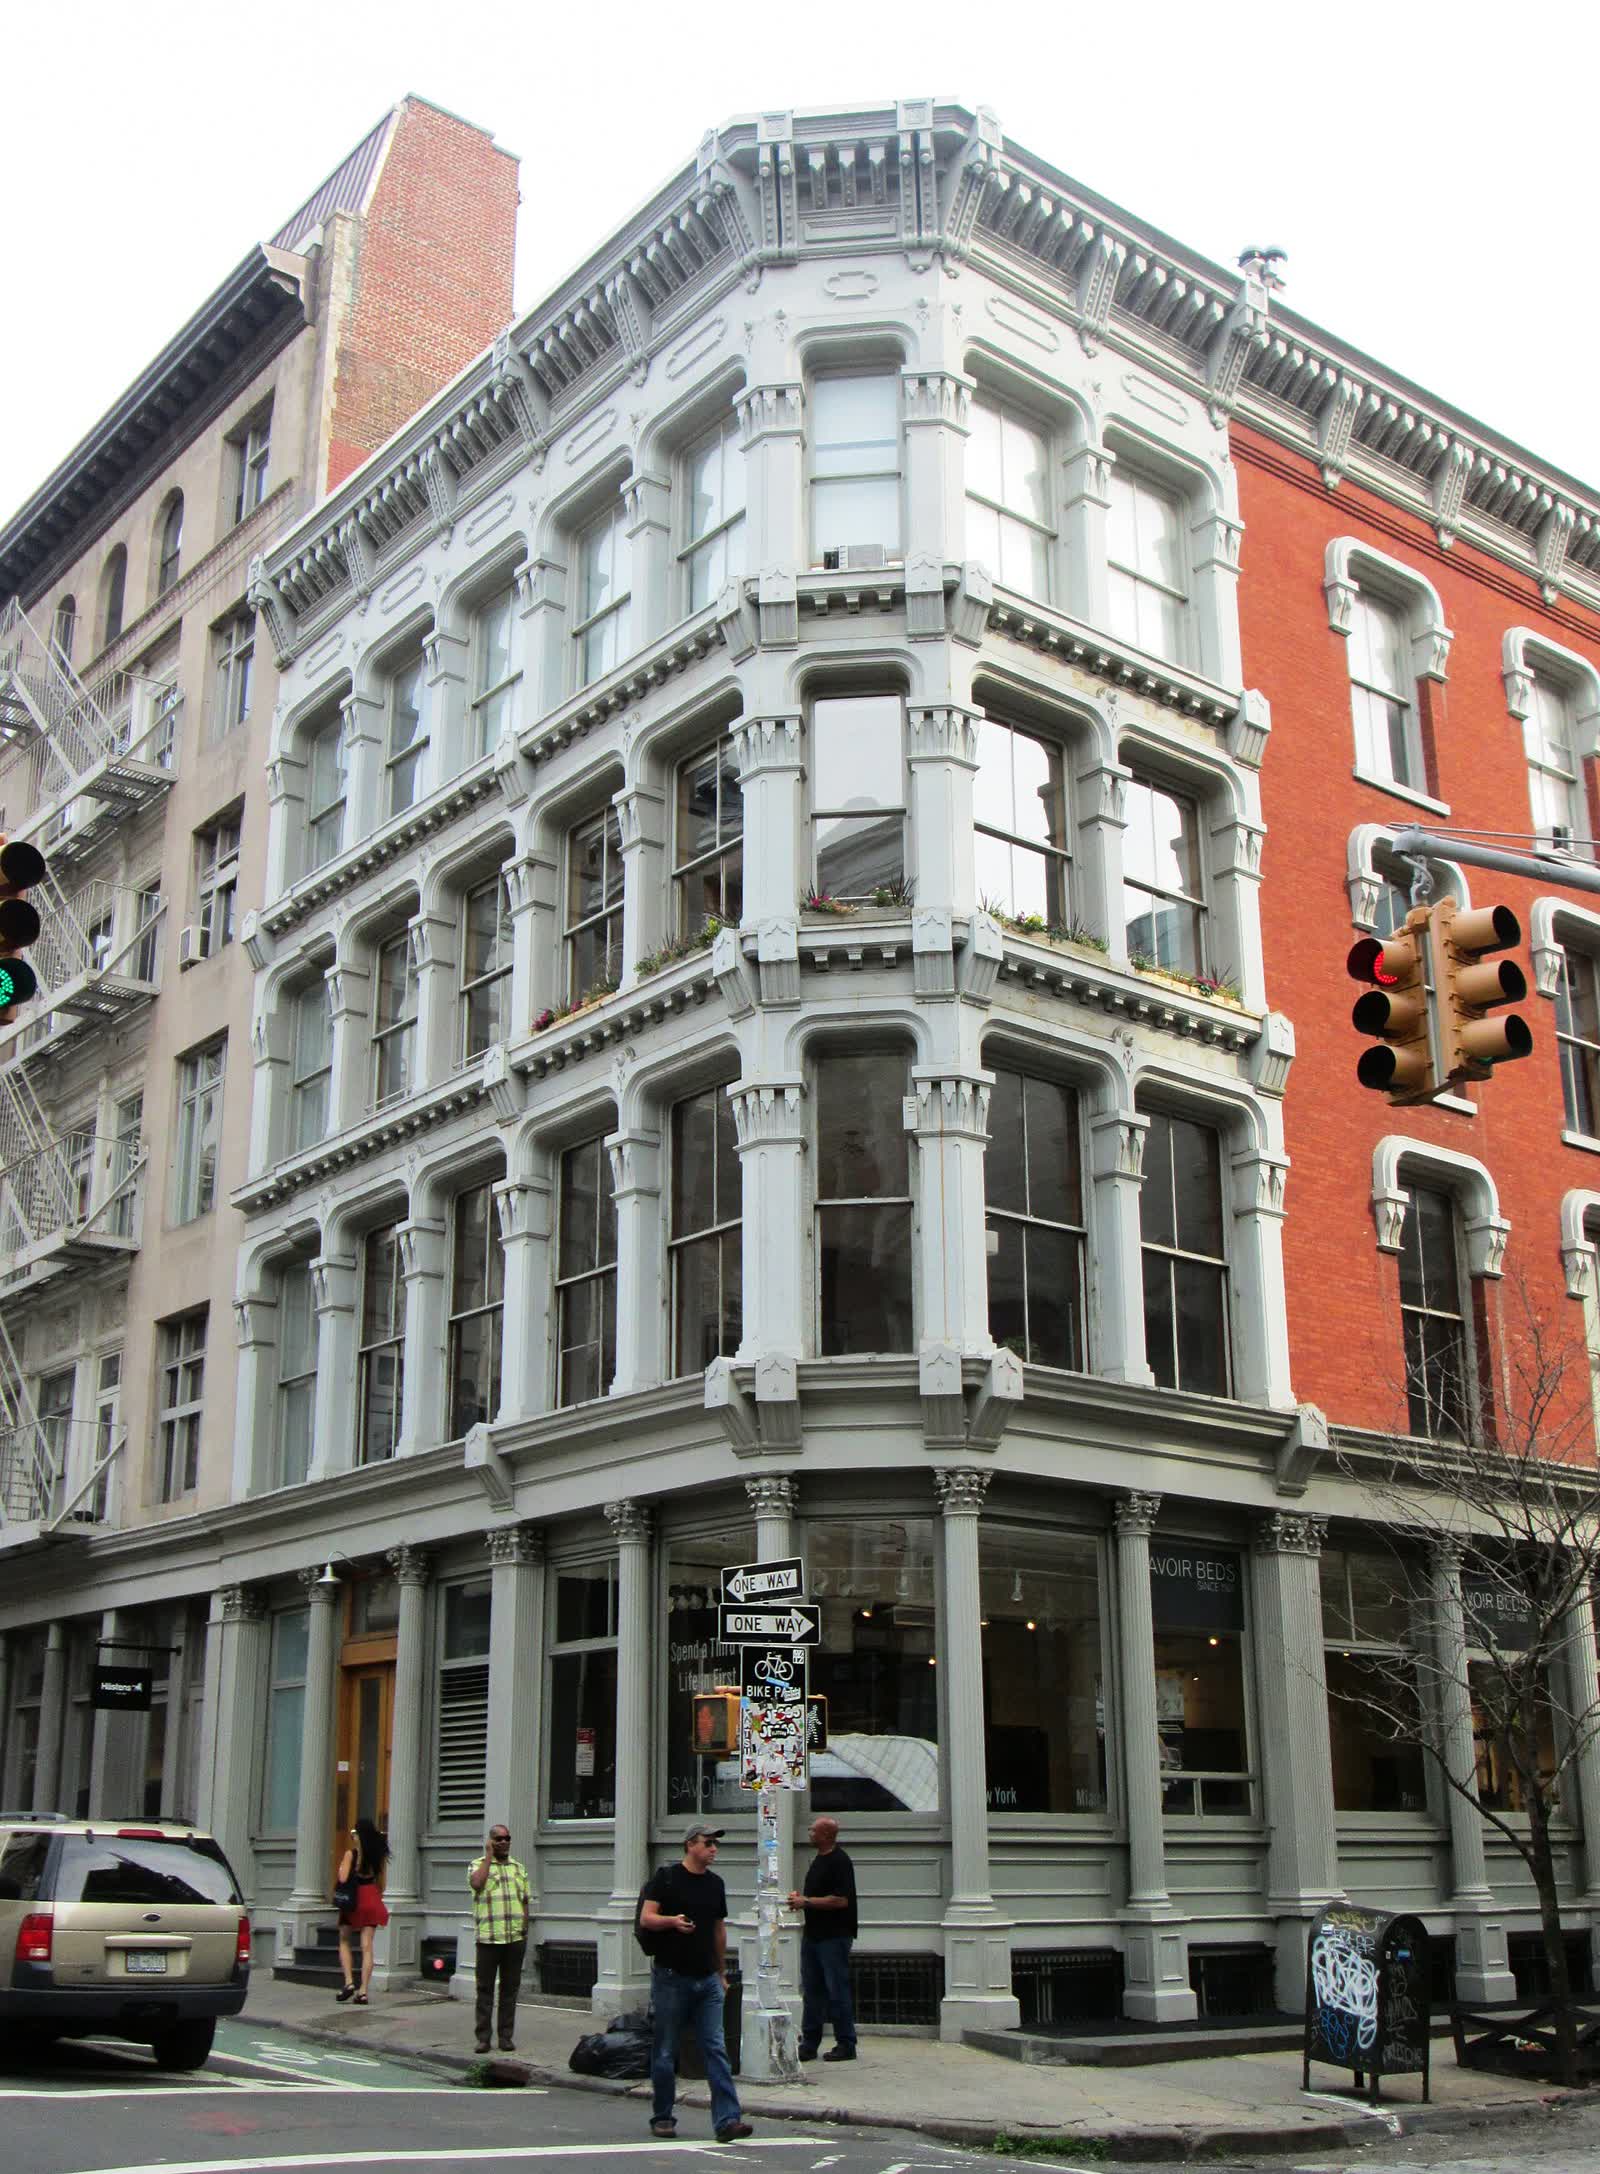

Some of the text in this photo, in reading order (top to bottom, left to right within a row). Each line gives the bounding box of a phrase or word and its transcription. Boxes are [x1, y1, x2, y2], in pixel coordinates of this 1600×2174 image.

[1196, 1561, 1236, 1582] BEDS
[734, 1572, 791, 1593] ONE WAY
[734, 1617, 804, 1632] ONE WAY
[671, 1640, 699, 1665] Spend
[679, 1671, 697, 1692] Life
[746, 1685, 771, 1697] BIKE
[774, 1686, 801, 1699] PA
[995, 1787, 1017, 1804] York
